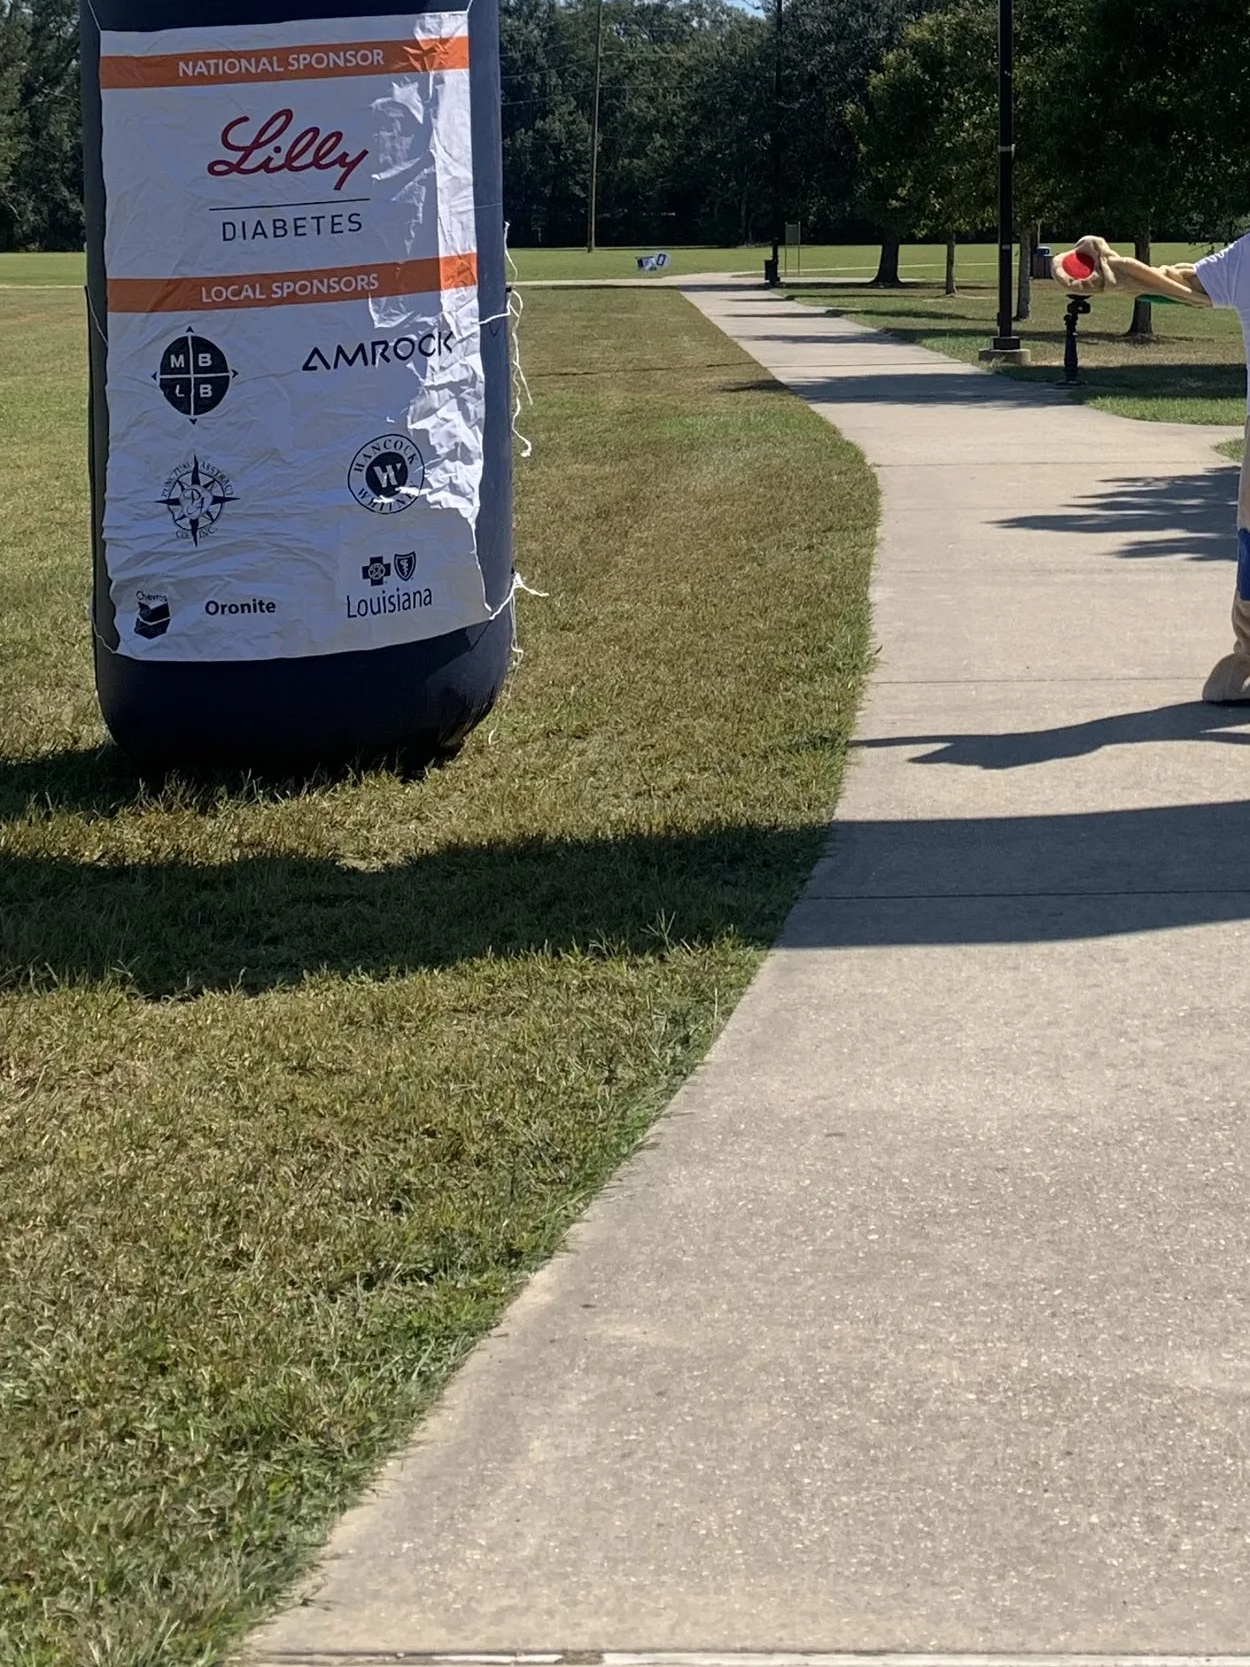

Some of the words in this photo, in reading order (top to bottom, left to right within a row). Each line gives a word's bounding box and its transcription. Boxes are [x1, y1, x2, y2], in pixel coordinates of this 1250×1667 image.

[178, 54, 284, 78] NATIONAL
[287, 48, 385, 71] SPONSOR
[207, 108, 369, 191] Lilly
[222, 213, 363, 242] DIABETES
[201, 282, 267, 304] LOCAL
[271, 274, 380, 300] SPONSORS
[302, 331, 454, 371] AMROCK
[354, 438, 418, 472] HANCOCK
[205, 598, 276, 616] Oronite
[346, 587, 433, 619] Louisiana
